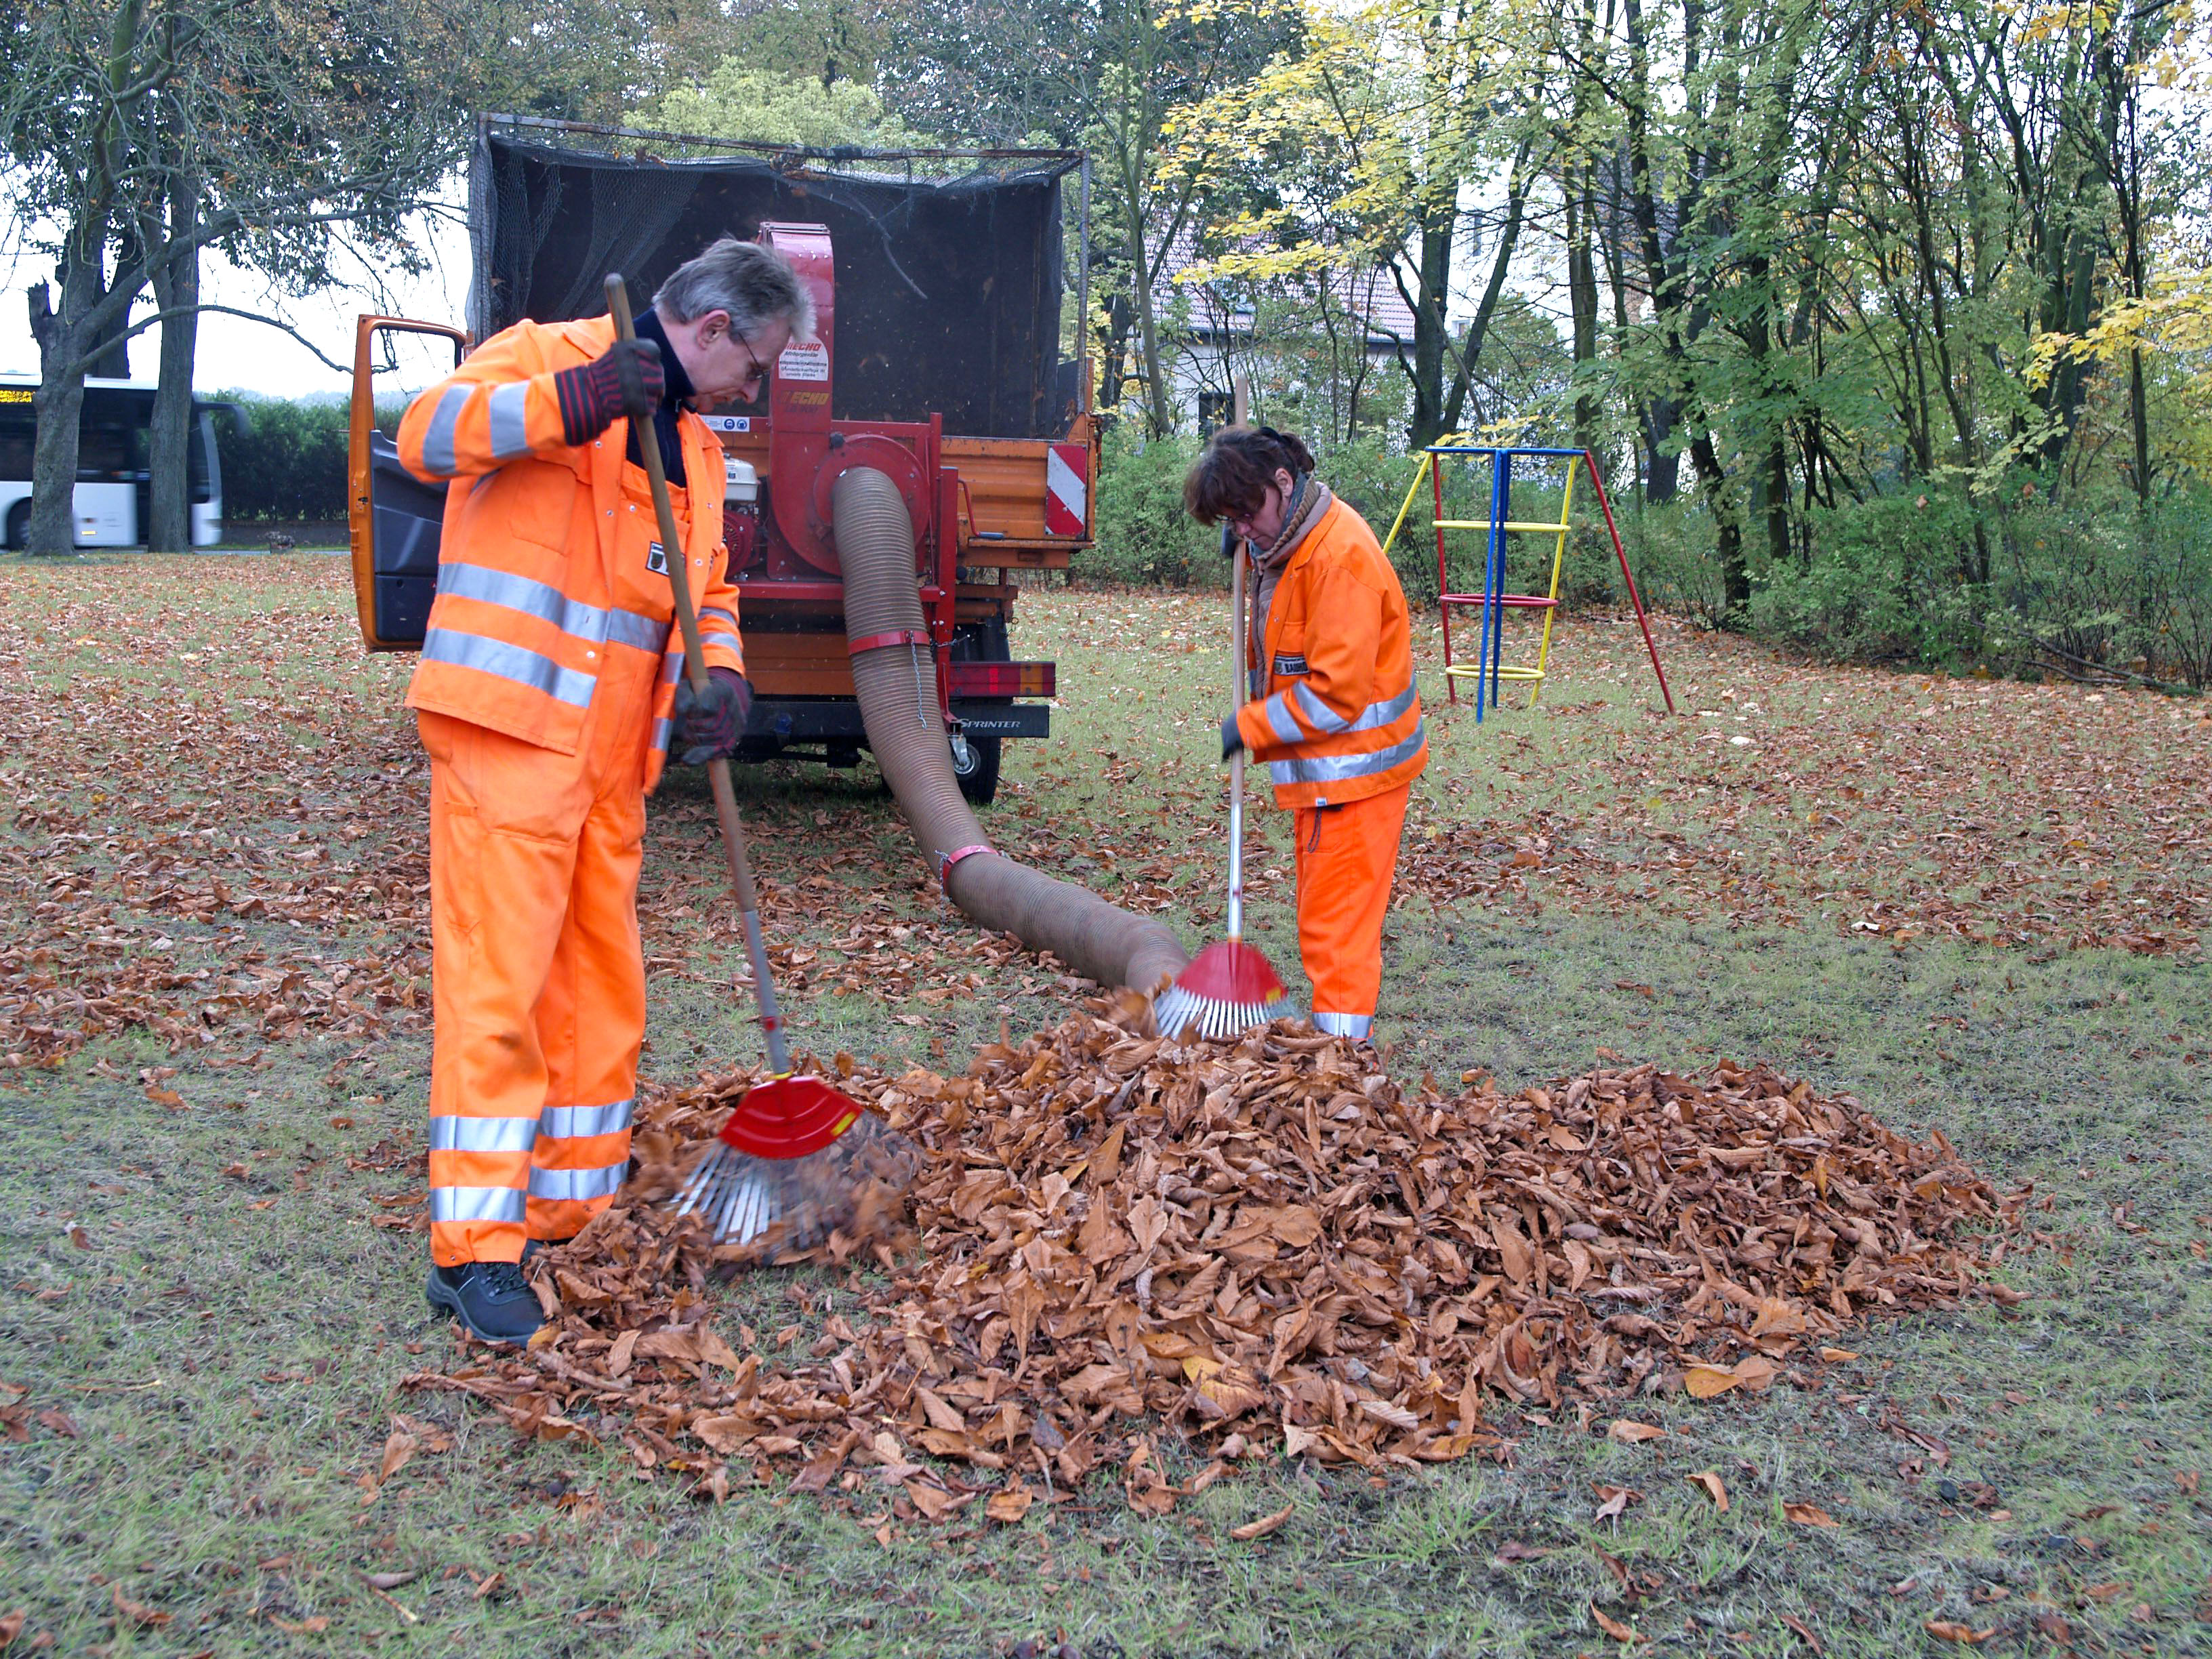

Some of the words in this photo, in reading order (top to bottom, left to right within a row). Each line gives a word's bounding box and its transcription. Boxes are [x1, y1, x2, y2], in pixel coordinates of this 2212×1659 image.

[791, 343, 822, 351] ECHO
[791, 391, 830, 405] ECHO
[960, 718, 1021, 728] SPRINTER
